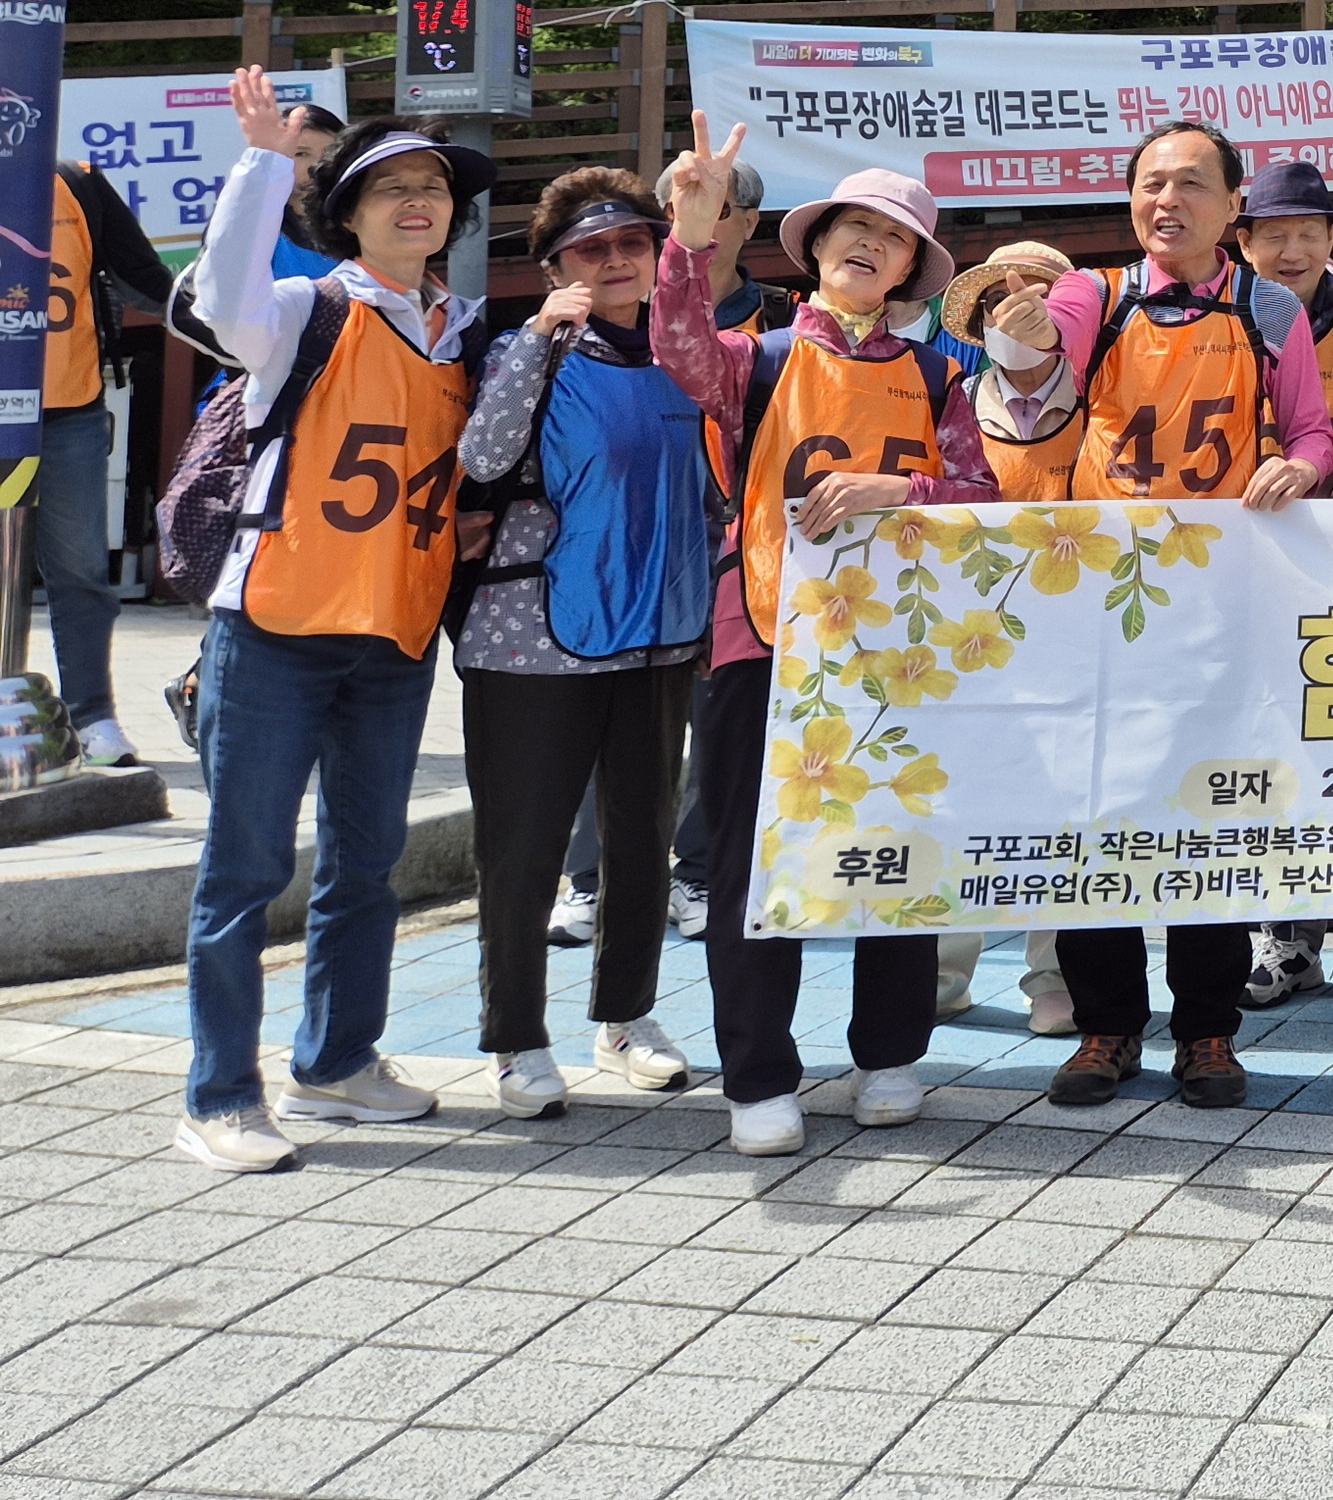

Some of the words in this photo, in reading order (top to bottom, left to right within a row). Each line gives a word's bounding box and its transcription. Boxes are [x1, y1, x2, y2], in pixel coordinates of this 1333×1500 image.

[0, 1, 66, 24] USAN
[799, 45, 812, 61] 더
[814, 46, 860, 62] 기대되는
[974, 89, 1109, 137] 데크로드는
[1117, 85, 1169, 133] 뛰는
[82, 120, 202, 169] 없고
[1105, 395, 1232, 497] 45
[320, 422, 453, 552] 54
[1207, 769, 1272, 806] 일자
[832, 845, 911, 888] 후원
[963, 831, 1090, 867] 구포교회,
[958, 872, 1142, 906] 매일유업(주),
[1152, 866, 1270, 902] (주)비락,
